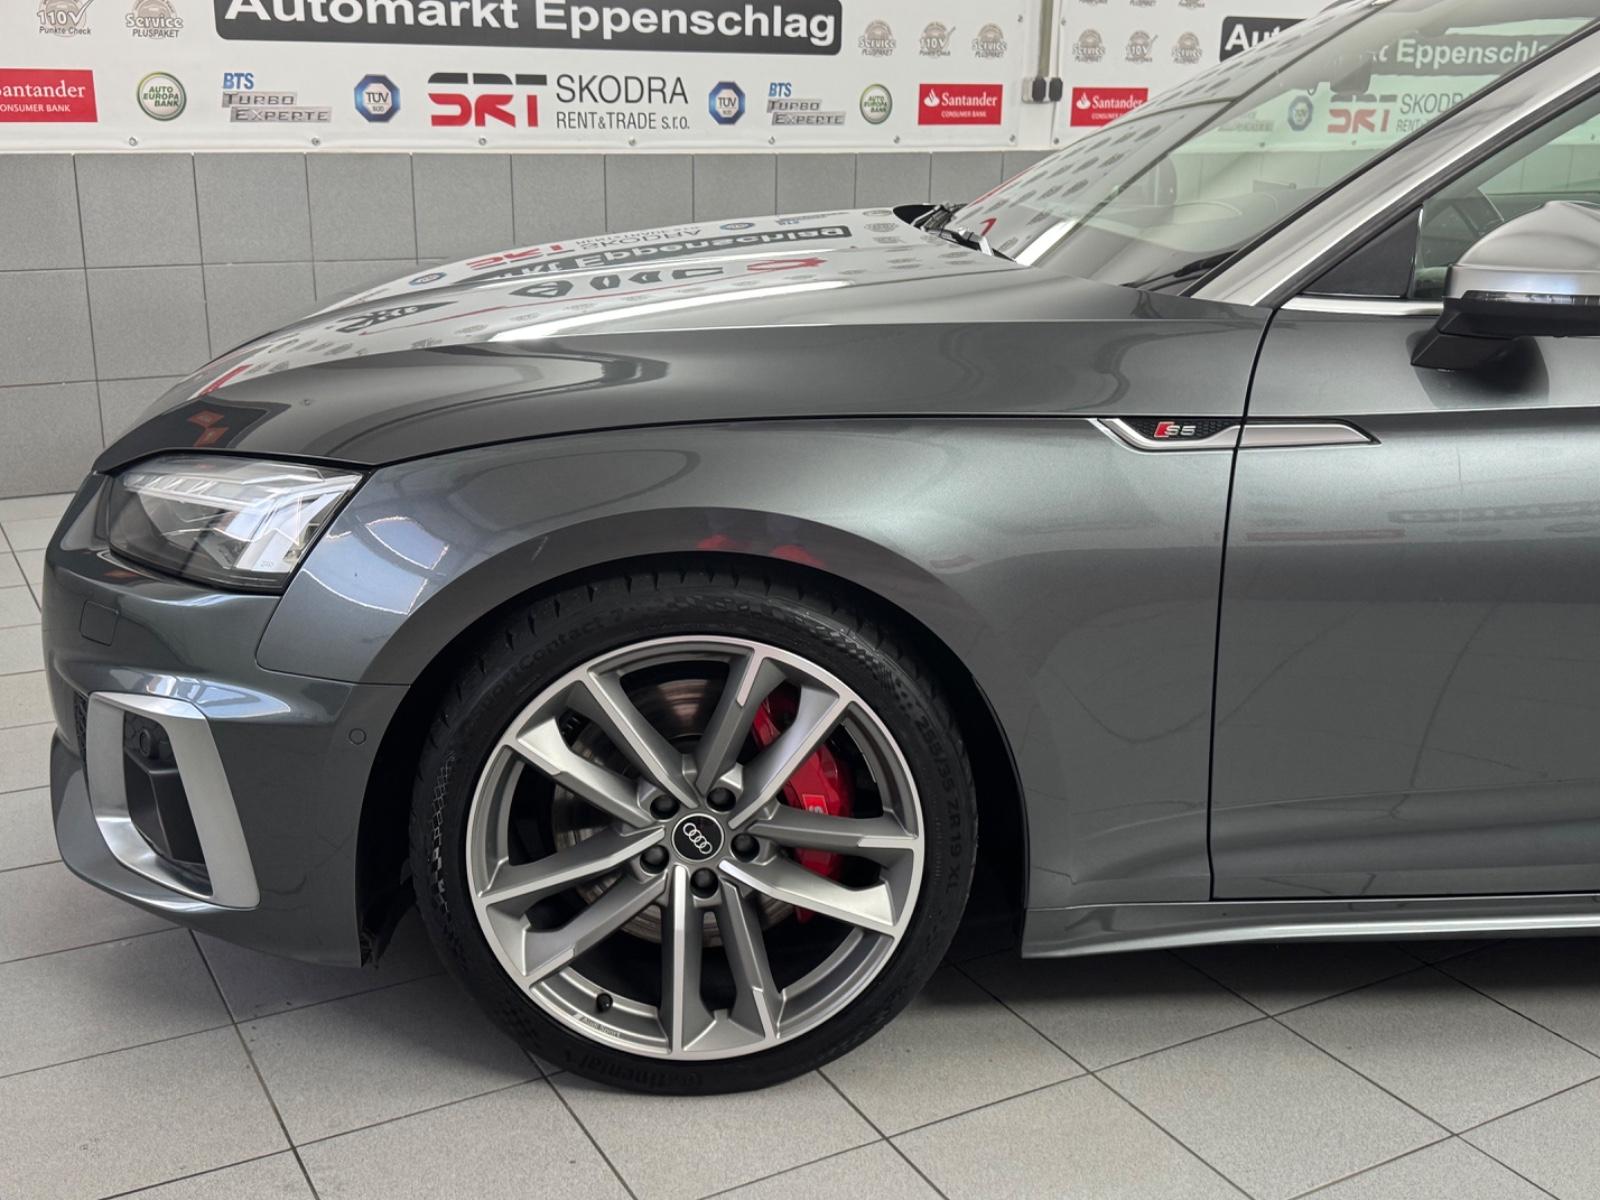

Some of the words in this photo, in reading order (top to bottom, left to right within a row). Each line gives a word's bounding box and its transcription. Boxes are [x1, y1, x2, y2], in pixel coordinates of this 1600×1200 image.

[126, 13, 183, 28] Service
[224, 0, 519, 29] Automarkt
[536, 0, 835, 46] Eppenschlag
[68, 26, 91, 35] Check
[132, 29, 179, 38] PLUSPAKET
[223, 72, 254, 90] BTS
[556, 74, 688, 104] SKODRA
[768, 82, 792, 97] BTS
[428, 72, 547, 128] SRT
[941, 91, 997, 107] Santander
[47, 104, 71, 113] BANK
[557, 112, 657, 130] RENT&TRADE
[661, 115, 690, 130] s.r.o.
[1160, 422, 1196, 436] S5
